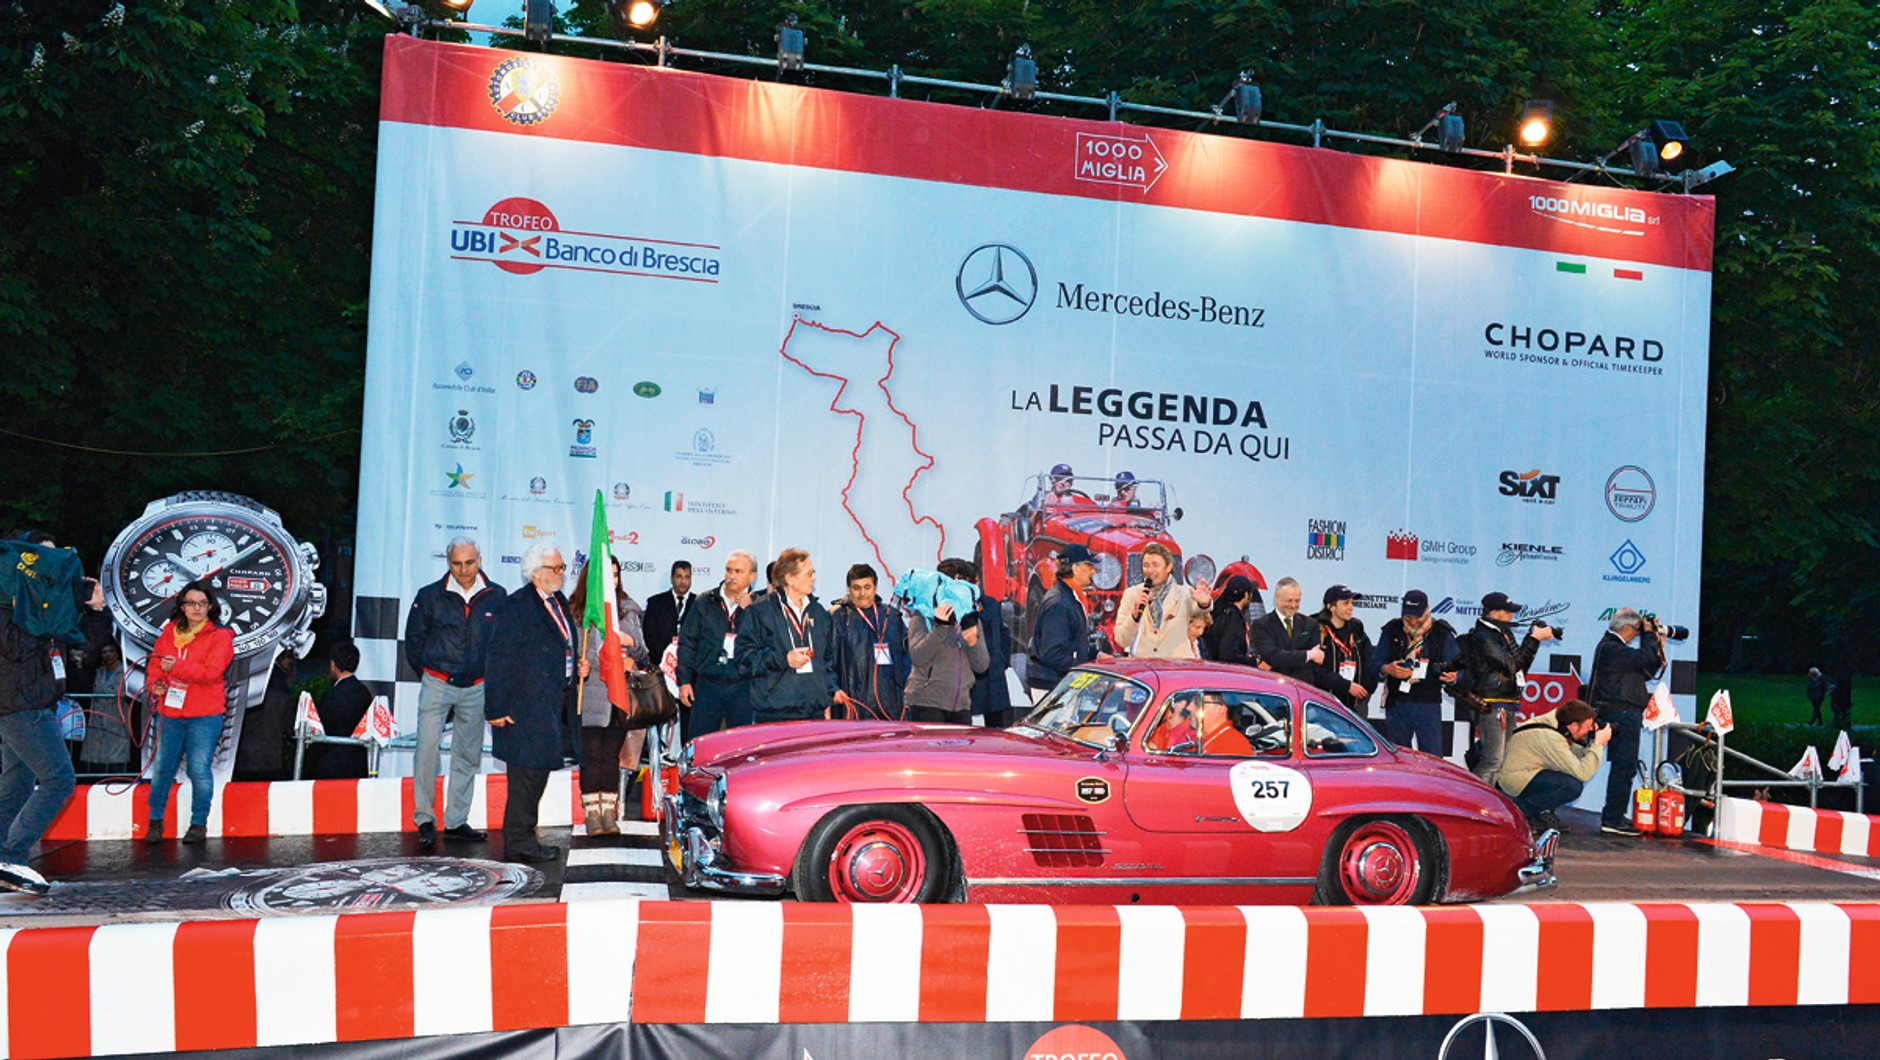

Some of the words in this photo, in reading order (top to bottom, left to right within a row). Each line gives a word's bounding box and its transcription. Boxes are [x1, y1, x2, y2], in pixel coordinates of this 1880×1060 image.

[1086, 140, 1142, 160] 1000
[1081, 160, 1145, 182] MIGLIA
[490, 211, 552, 231] TROFEO
[1648, 216, 1660, 225] srl
[450, 229, 495, 254] UBI
[545, 238, 615, 265] Banco
[619, 246, 638, 267] di
[642, 248, 720, 276] Brescia
[1056, 281, 1266, 328] Mercedes-Benz
[1485, 323, 1664, 362] CHOPARD
[1484, 350, 1517, 361] WORLD
[1519, 353, 1559, 365] SPONSOR
[1571, 359, 1609, 371] OFFICIAL
[1611, 363, 1663, 376] TIMEKEEPER
[576, 379, 596, 390] FIA
[1011, 390, 1043, 412] LA
[1049, 384, 1268, 429] LEGGENDA
[1099, 423, 1187, 452] PASSA
[1194, 430, 1233, 455] DA
[1240, 433, 1290, 462] QUI
[1308, 518, 1346, 535] FASHION
[1307, 545, 1345, 561] DISTRICT
[1421, 540, 1446, 553] GMH
[1447, 541, 1477, 557] Group
[1502, 543, 1563, 554] KIENLE
[229, 568, 271, 577] CHOPARD
[1251, 780, 1290, 799] 257
